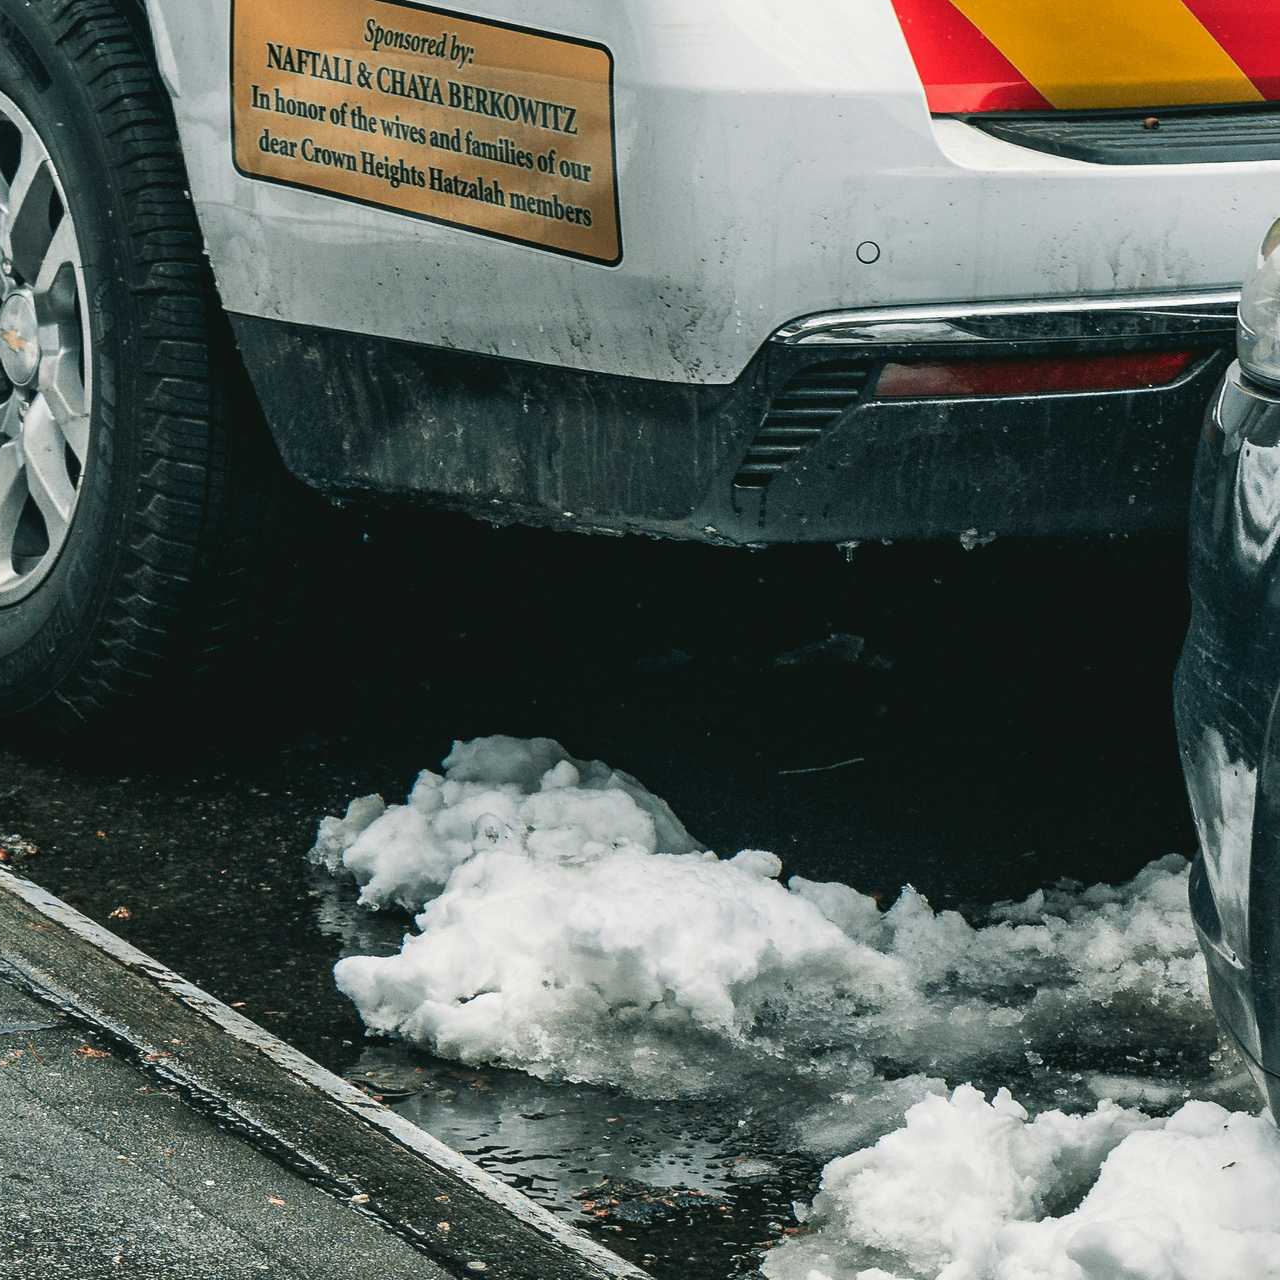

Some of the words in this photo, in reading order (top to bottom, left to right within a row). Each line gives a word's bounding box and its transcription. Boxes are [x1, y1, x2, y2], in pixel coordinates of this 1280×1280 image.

[266, 42, 352, 86] NAFTALI
[357, 64, 372, 90] &
[376, 66, 444, 106] CHAYA
[447, 81, 578, 136] BERKOWITZ
[364, 18, 447, 60] Sponsored
[450, 34, 475, 69] by:
[251, 85, 271, 111] In
[274, 90, 325, 122] honor
[329, 103, 349, 127] of
[351, 106, 377, 134] the
[380, 115, 426, 146] wives
[429, 127, 461, 154] and
[465, 129, 534, 170] families
[537, 149, 557, 175] of
[559, 158, 592, 183] our
[258, 128, 297, 158] dear
[301, 138, 357, 172] Crown
[361, 151, 425, 189] Heights
[429, 166, 505, 207] Hatzalah
[509, 190, 593, 228] members
